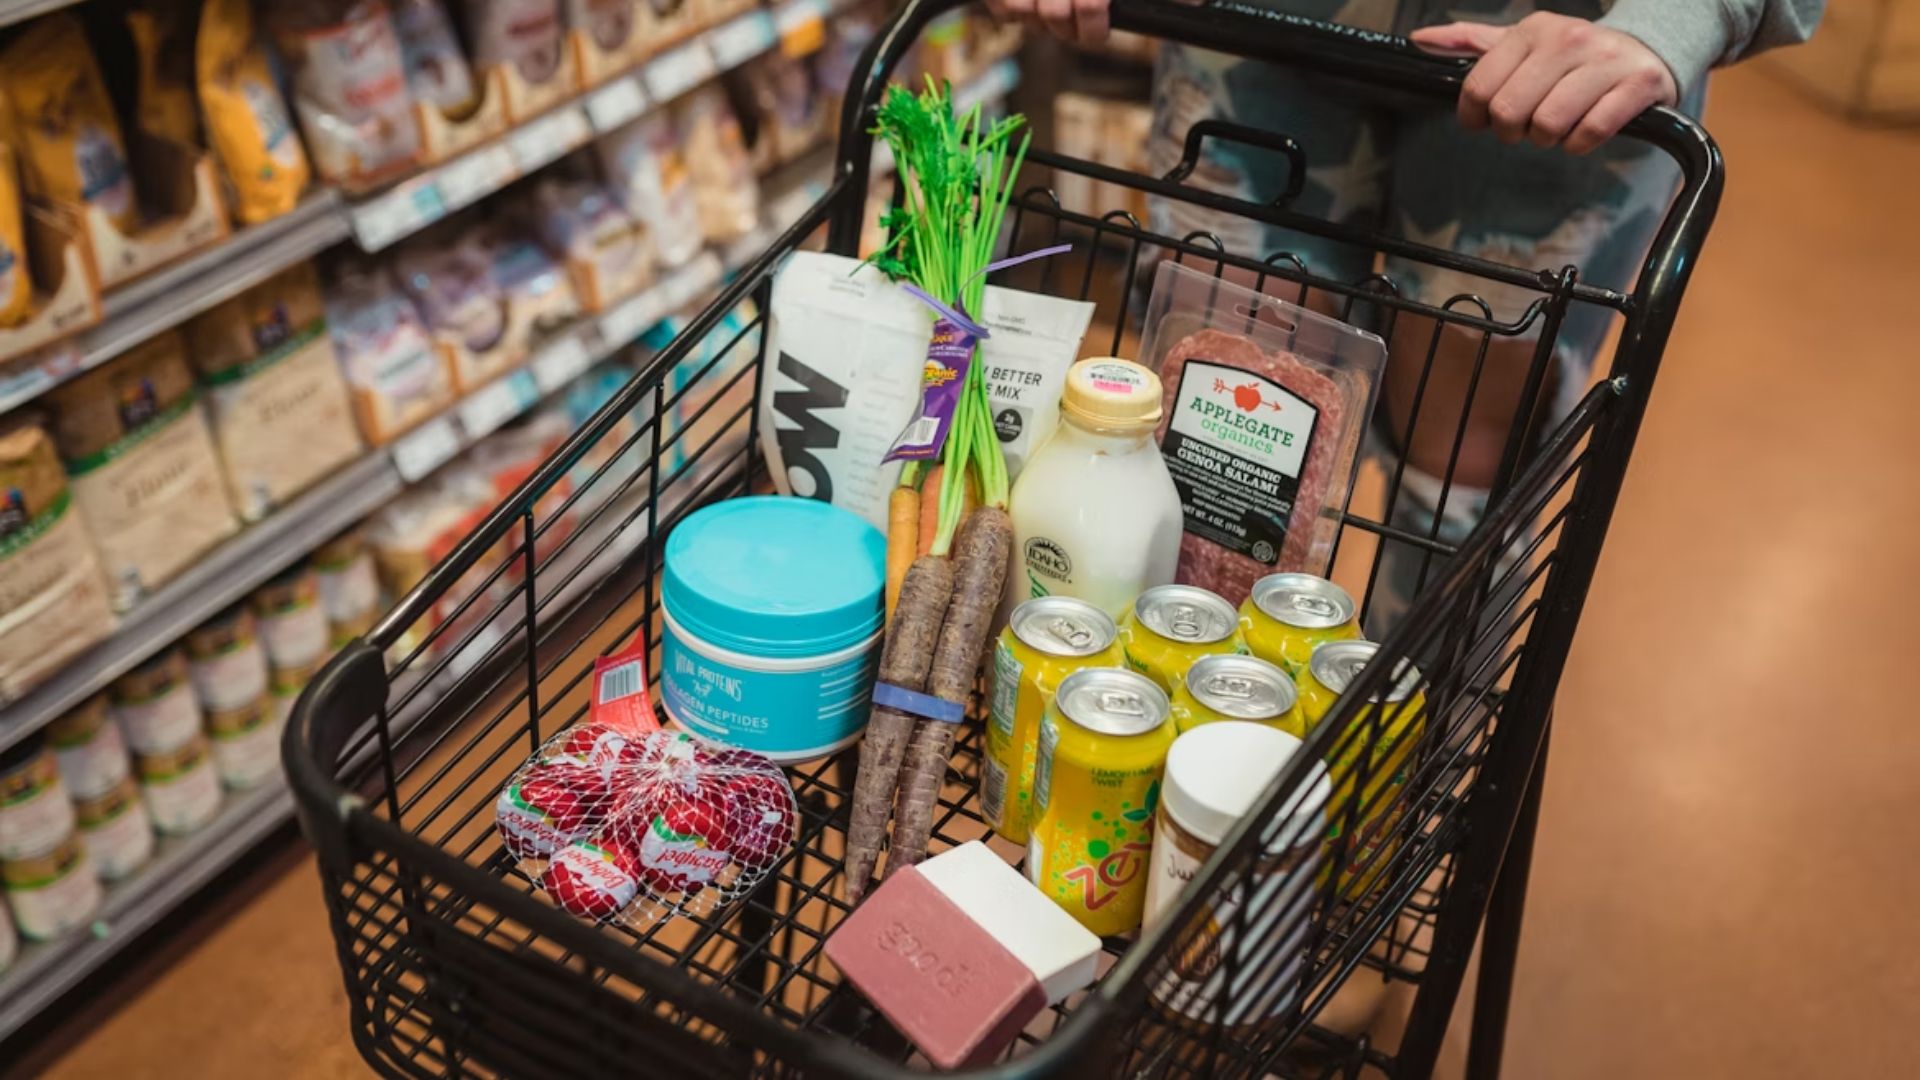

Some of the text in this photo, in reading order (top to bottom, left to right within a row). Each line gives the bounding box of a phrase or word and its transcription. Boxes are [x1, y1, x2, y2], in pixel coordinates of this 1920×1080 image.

[991, 366, 1043, 387] BETTER
[994, 384, 1022, 400] MIX
[1190, 395, 1295, 447] APPLEGATE
[1201, 418, 1273, 454] organics
[1176, 447, 1222, 474] GENOA
[1224, 465, 1280, 496] SALAMI
[1180, 438, 1231, 464] UNCURED
[1231, 457, 1282, 484] ORGANIC
[697, 665, 743, 703] PROTEINS
[706, 704, 770, 730] PEPTIDES
